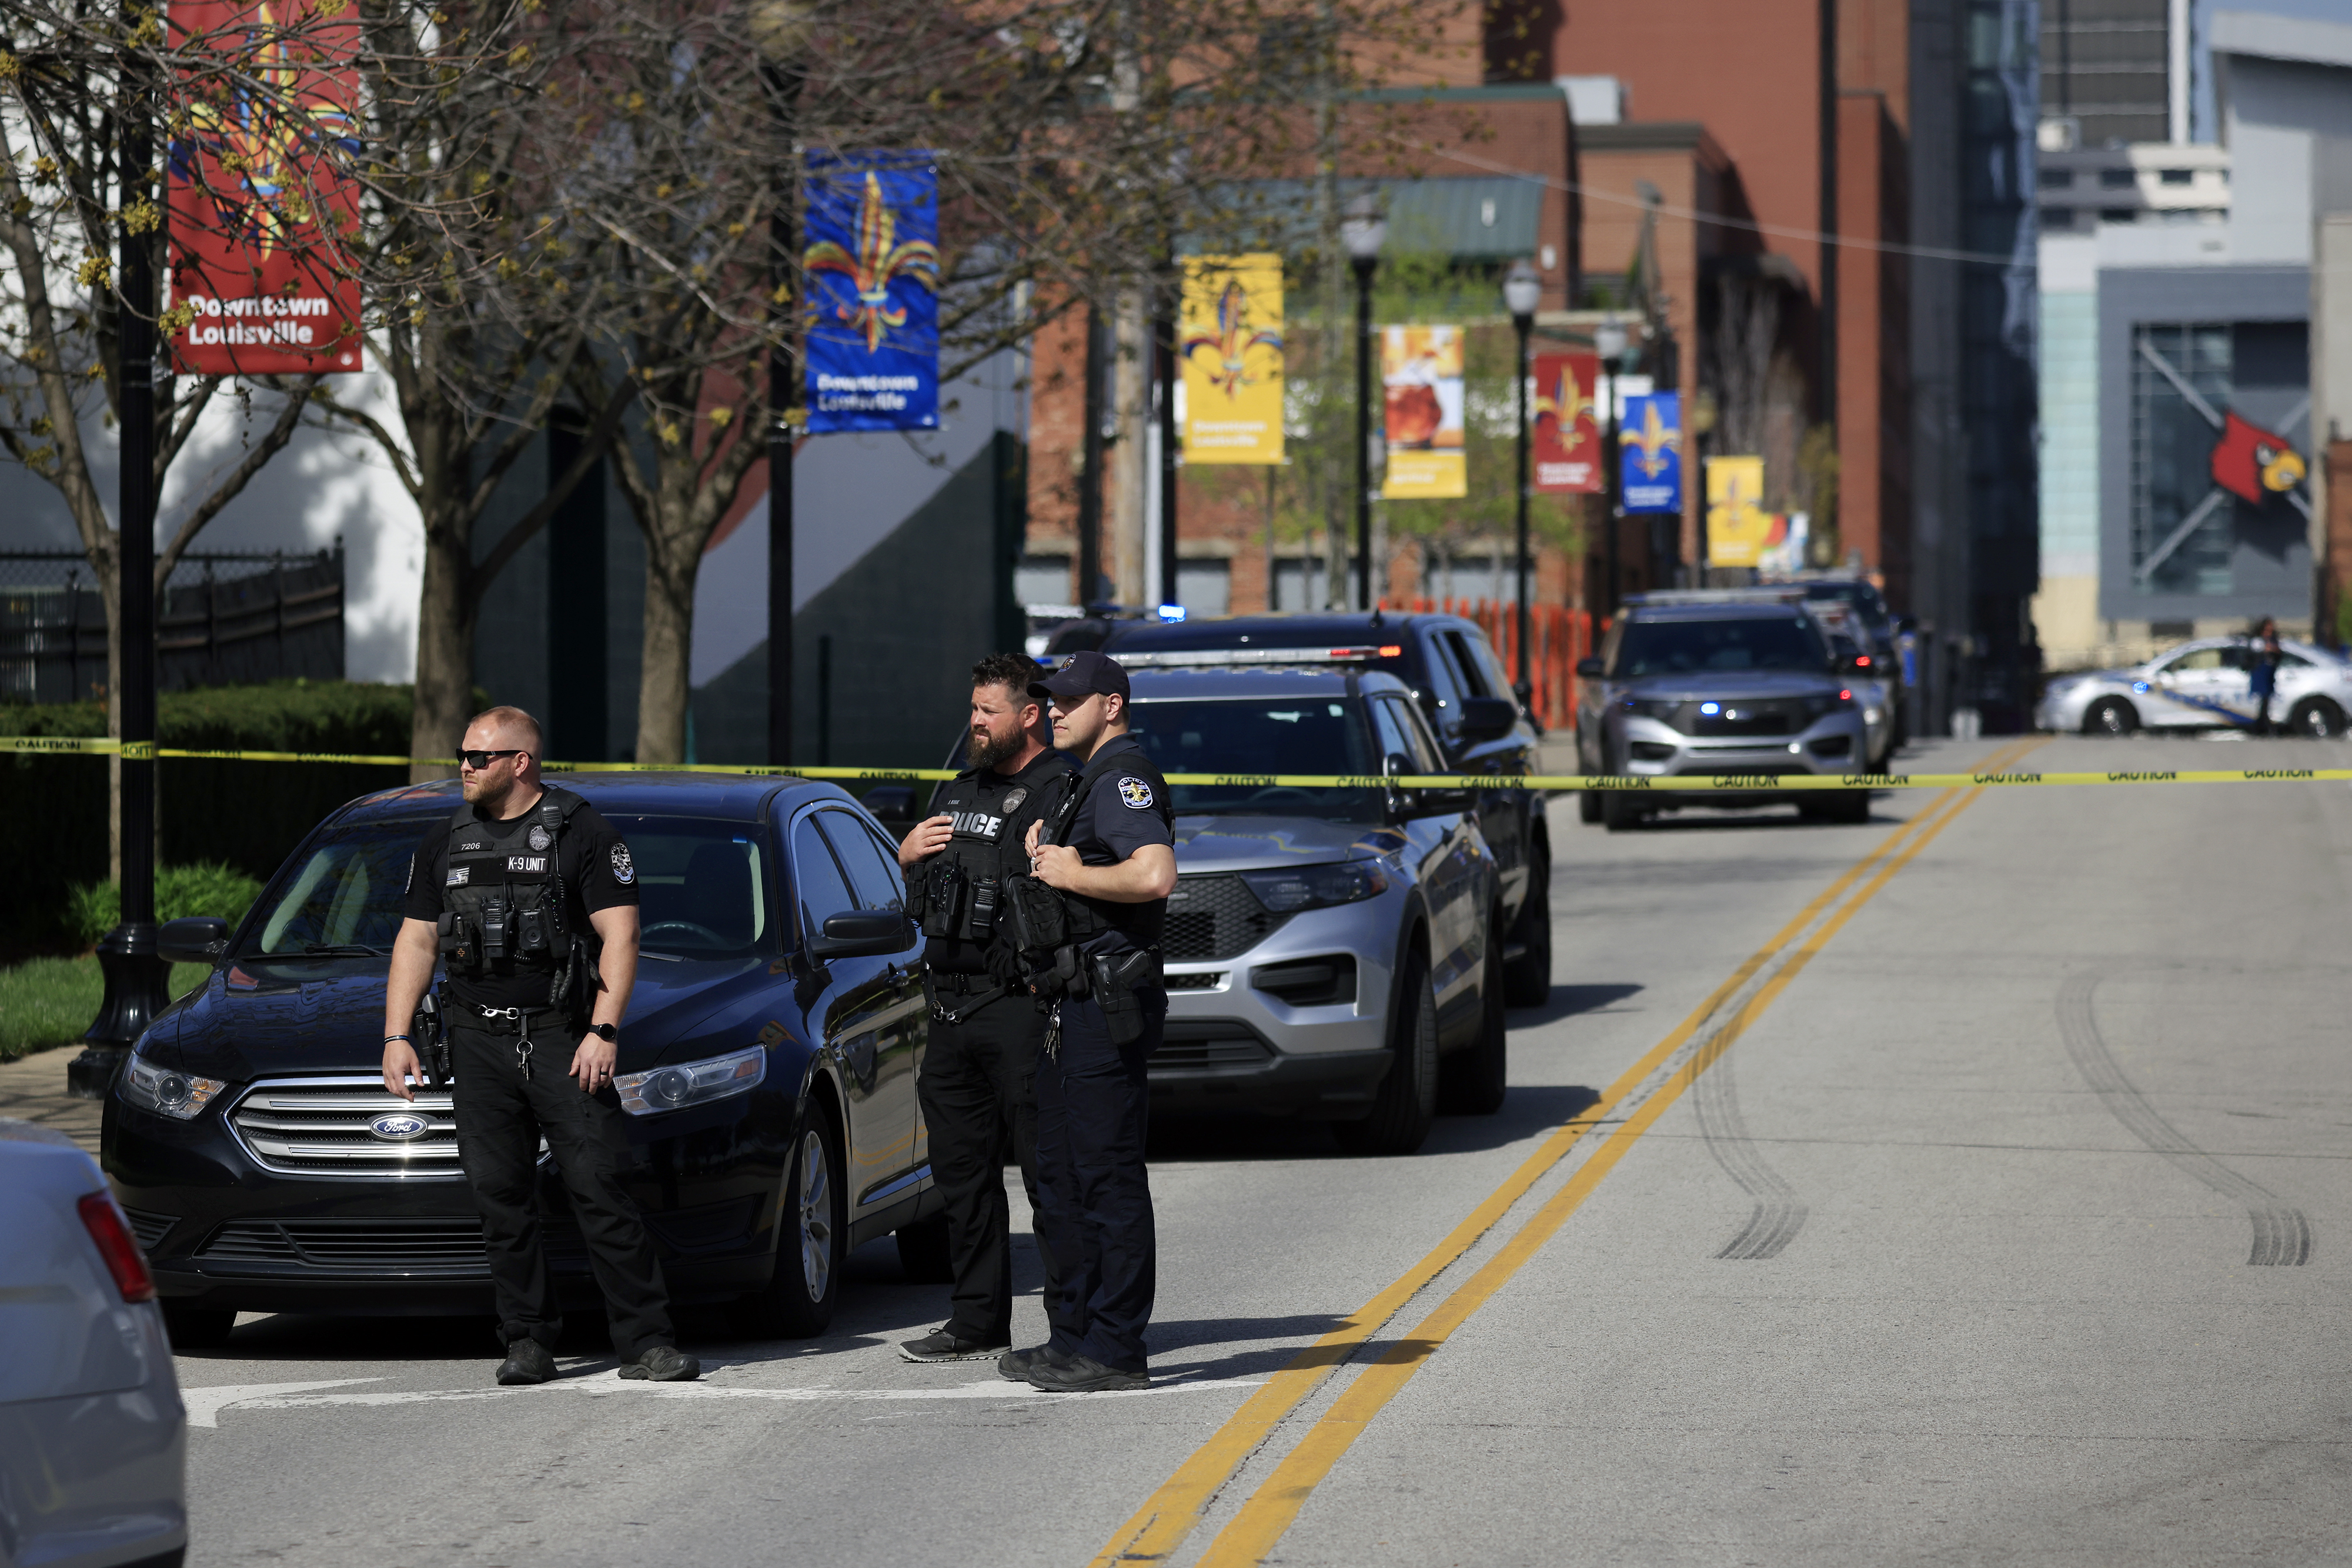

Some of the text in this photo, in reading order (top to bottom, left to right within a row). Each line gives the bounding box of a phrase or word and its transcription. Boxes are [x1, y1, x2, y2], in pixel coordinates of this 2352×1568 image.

[188, 295, 329, 317] Downtown
[189, 320, 314, 345] Louisville
[15, 740, 81, 750] CAUTION
[1215, 770, 2314, 789] CAUTION CAUTION CAUTION CAUTION CAUTION CAUTION CAUTION CAUTION CAUTION
[508, 857, 546, 871] K-9 UNIT
[384, 1120, 413, 1132] Ford
